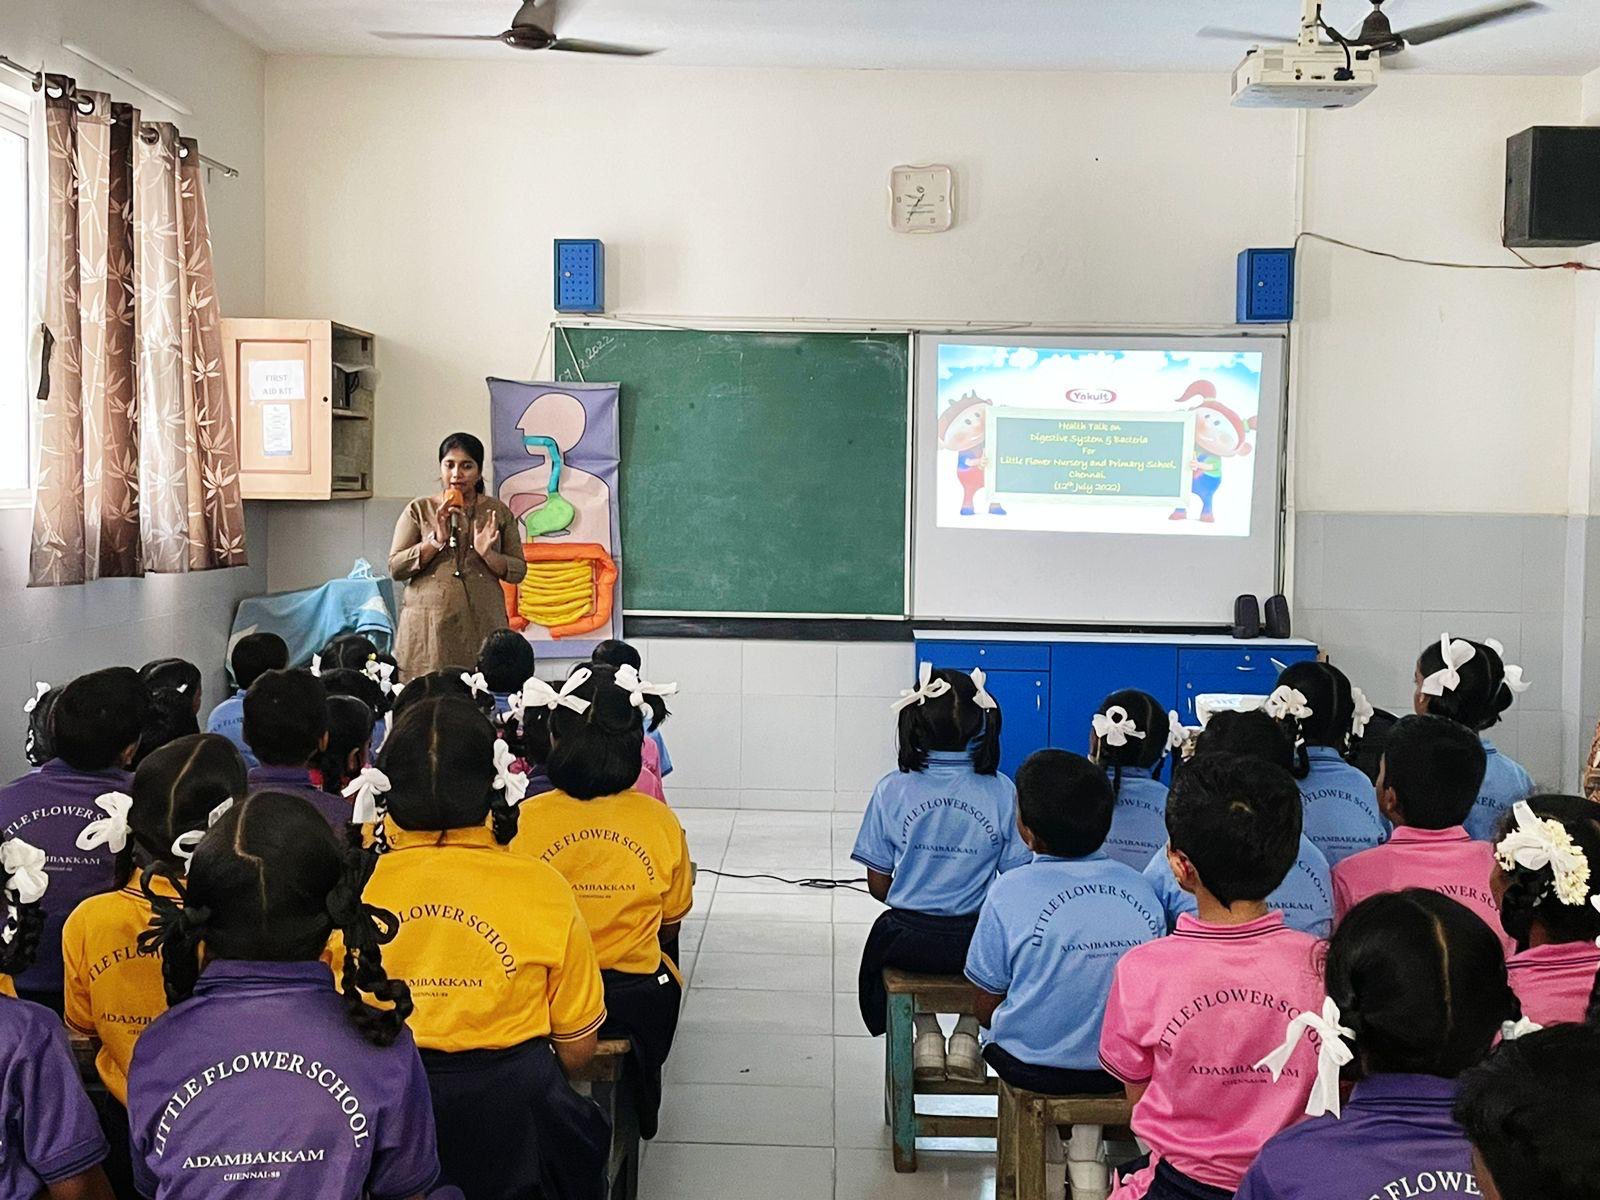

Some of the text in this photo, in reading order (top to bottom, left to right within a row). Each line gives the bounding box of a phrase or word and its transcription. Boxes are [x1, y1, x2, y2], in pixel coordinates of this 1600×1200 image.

[264, 374, 289, 382] FIRST
[262, 387, 293, 395] AID KIT
[1074, 392, 1110, 401] Yakult
[1059, 422, 1087, 431] Health
[1089, 423, 1108, 431] Talk
[1030, 433, 1068, 444] Digestive
[1071, 434, 1104, 446] System
[1113, 435, 1148, 444] Bacteria
[1082, 447, 1096, 455] For
[1000, 456, 1023, 464] Little
[1024, 457, 1051, 465] Flower
[1053, 459, 1089, 470] Nursery
[1089, 459, 1107, 467] and
[1109, 460, 1145, 471] Primary
[1073, 483, 1093, 494] July
[5, 814, 31, 835] TLE
[31, 805, 95, 820] FLOWER
[920, 798, 968, 812] FLOWER
[968, 806, 999, 849] SCHOOL
[46, 855, 101, 865] BAKKAM
[540, 828, 656, 885] TLE FLOWER SCHOOL
[1032, 884, 1159, 947] LITTLE FLOWER SCHOOL
[399, 904, 517, 980] LOWER SCHOOL
[408, 978, 483, 988] MBAKKAM
[1193, 989, 1274, 1012] FLOWER
[155, 1051, 369, 1157] LITTLE FLOWER SCHOOL
[182, 1149, 326, 1169] ADAMBAKKAM
[1383, 1170, 1483, 1200] FLOWE
